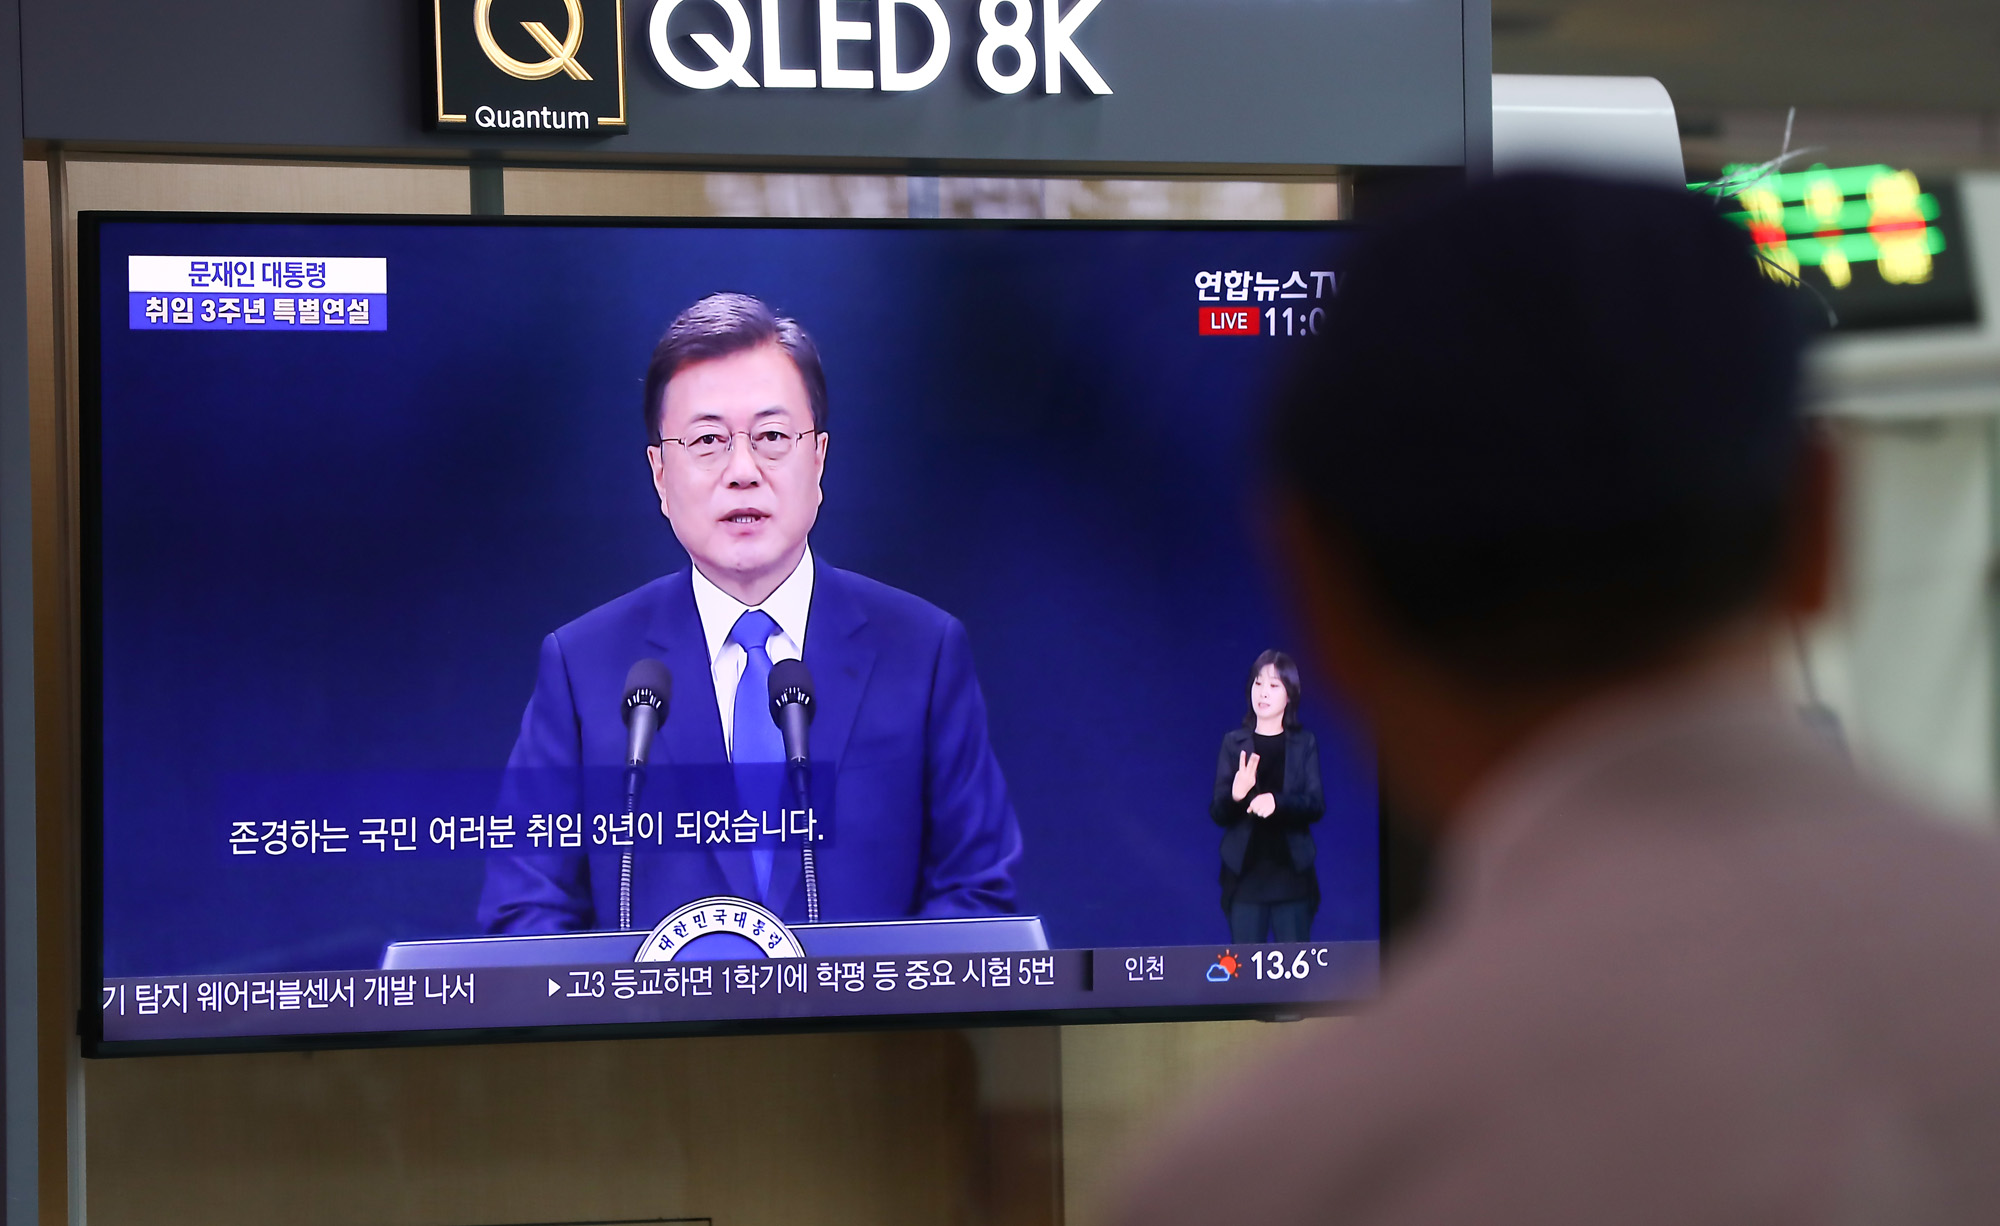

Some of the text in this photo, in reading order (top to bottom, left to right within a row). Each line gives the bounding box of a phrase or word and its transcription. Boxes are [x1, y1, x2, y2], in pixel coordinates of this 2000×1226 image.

[648, 0, 1114, 95] QLED 8K
[474, 105, 590, 130] Quantum
[188, 261, 326, 288] 문재인 대통령
[145, 296, 370, 325] 취임 3주년 특별연설
[1211, 312, 1248, 330] LIVE
[228, 808, 825, 856] 존경하는 국민 여러분 취임 3년이 되었습니다.
[566, 955, 1056, 999] 고3 등교하면 1학기에 학평 등 중요 시험 5번
[1125, 955, 1165, 981] 인천
[102, 973, 476, 1016] 기 탐지 웨어러블센서 개발 나서
